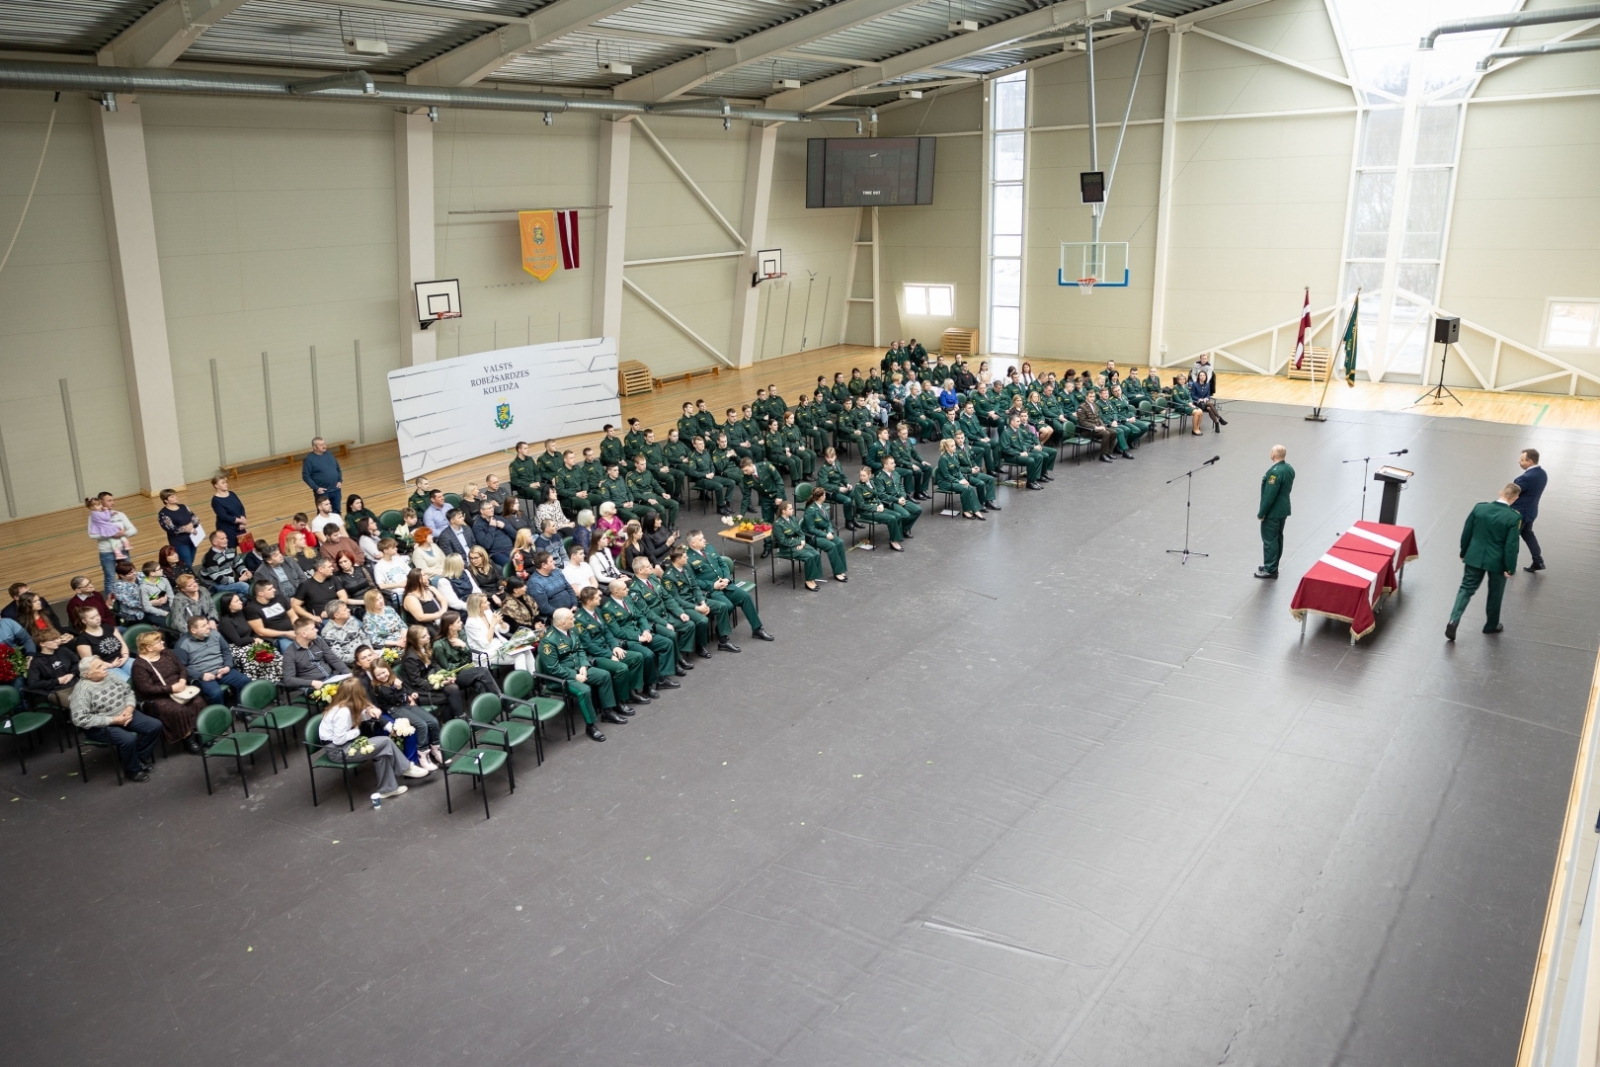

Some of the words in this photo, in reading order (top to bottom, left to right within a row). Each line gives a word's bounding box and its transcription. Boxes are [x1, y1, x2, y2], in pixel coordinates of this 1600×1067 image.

[483, 361, 513, 373] VALSTS
[470, 369, 530, 387] ROBEŽSARDZES
[483, 381, 520, 395] KOLEDŽA
